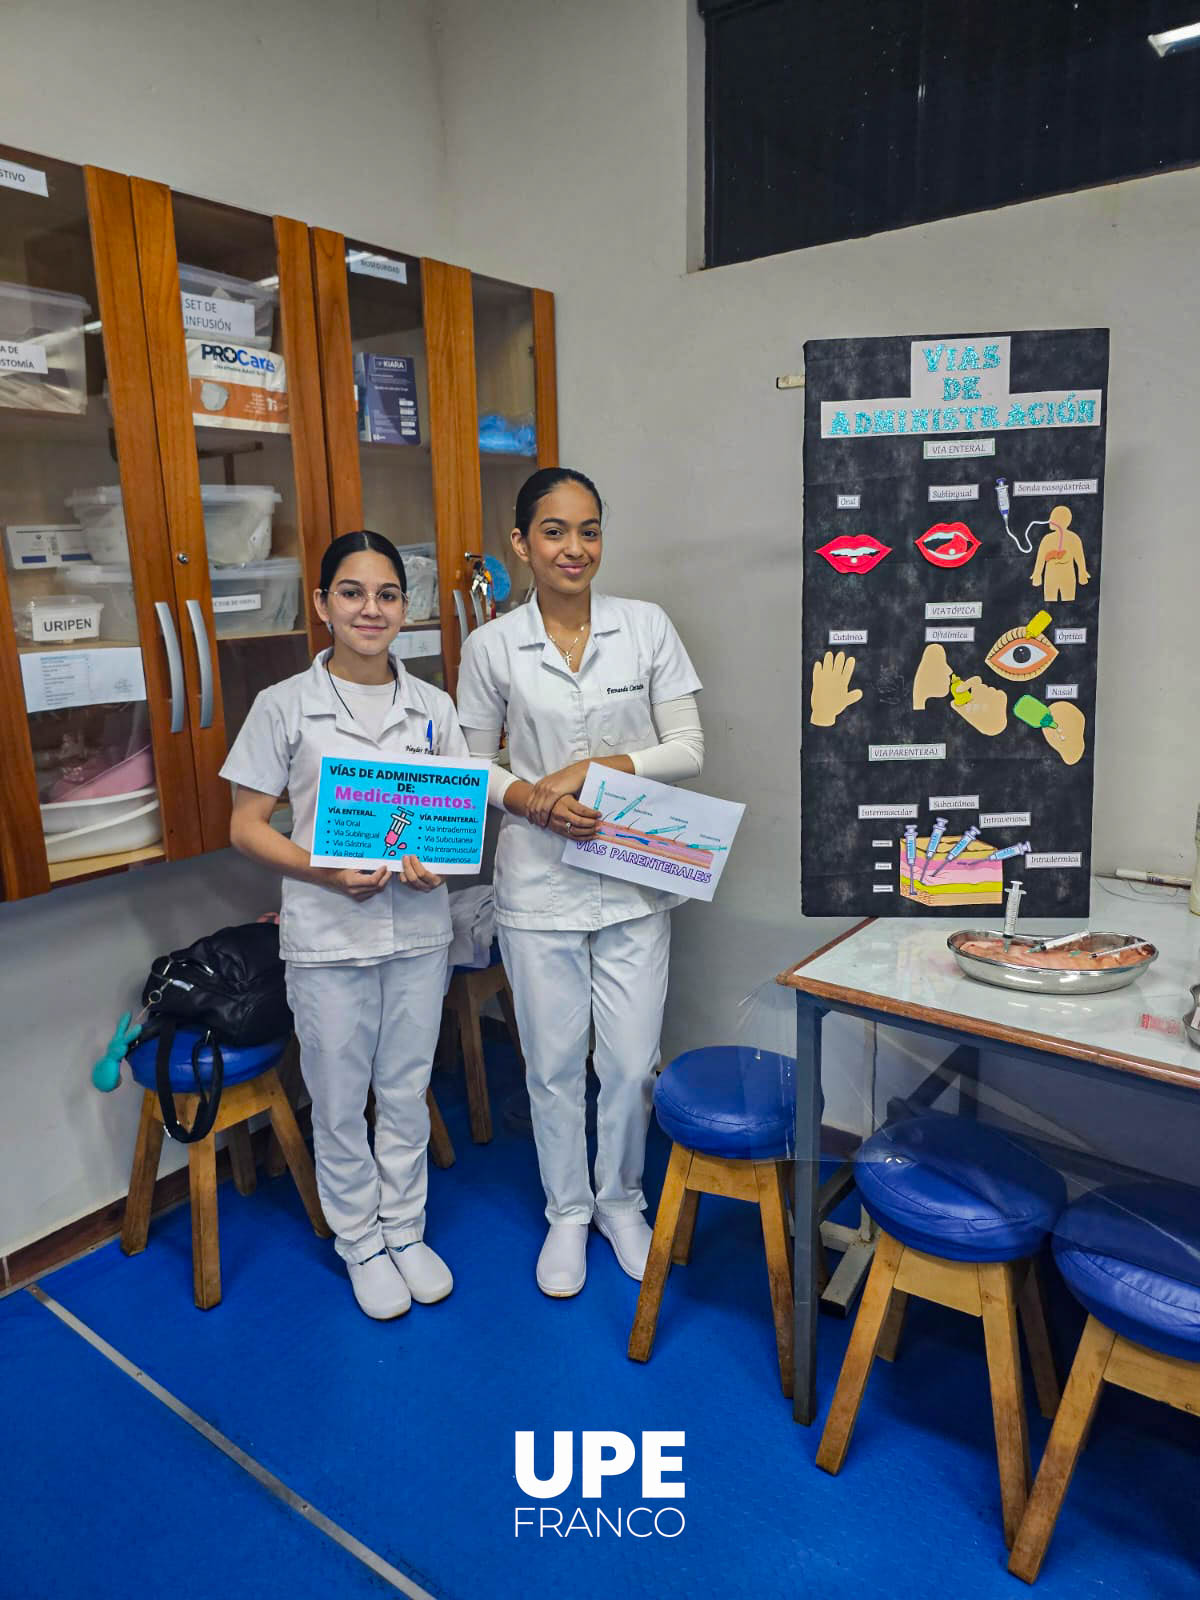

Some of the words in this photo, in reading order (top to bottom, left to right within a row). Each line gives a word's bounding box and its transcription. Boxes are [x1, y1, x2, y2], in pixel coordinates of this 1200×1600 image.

[185, 298, 201, 311] SET
[204, 301, 217, 314] DE
[185, 315, 232, 332] INFUSIÓN
[8, 345, 19, 355] DE
[201, 343, 275, 373] PROCare
[383, 359, 405, 369] KIARA
[922, 344, 1001, 373] VIAS
[942, 375, 983, 401] DE
[829, 392, 1096, 435] ADMINISTRACIÓN
[948, 444, 986, 454] ENTERAL
[1018, 483, 1040, 492] Sonda
[932, 488, 972, 500] Sublingual
[840, 497, 856, 506] Oral
[43, 617, 93, 633] URIPEN
[1051, 687, 1073, 696] Nasal
[329, 764, 356, 777] VÍAS
[358, 767, 375, 779] DE
[376, 771, 480, 787] ADMINISTRACIÓN
[397, 782, 415, 793] DE:
[335, 785, 476, 810] Medicamentos.
[345, 819, 361, 827] Oral
[345, 829, 380, 840] Sublingual
[434, 845, 478, 854] Intramuscular
[576, 840, 608, 856] VIAS
[609, 847, 713, 884] PARENTERALES
